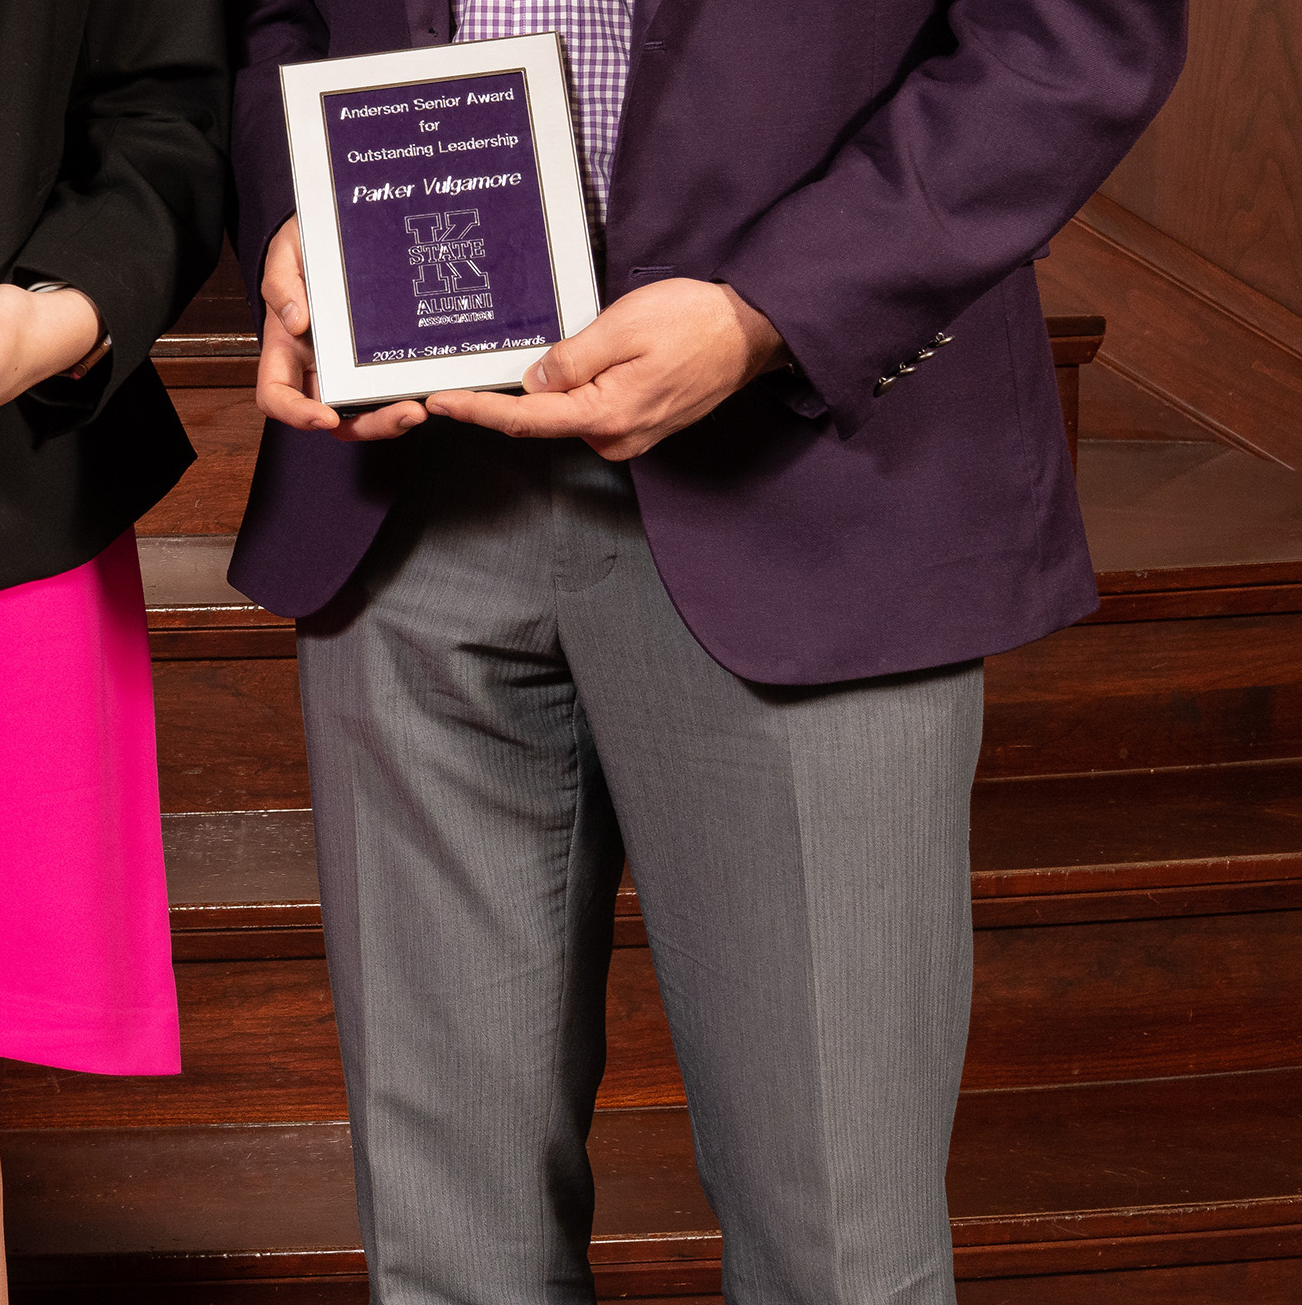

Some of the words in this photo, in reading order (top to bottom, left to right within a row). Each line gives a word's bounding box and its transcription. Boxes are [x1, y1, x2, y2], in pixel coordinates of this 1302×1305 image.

[340, 100, 409, 120] Anderson
[413, 95, 461, 111] Senior
[466, 88, 515, 105] Award
[418, 119, 440, 133] for
[347, 142, 434, 164] Outstanding
[438, 132, 519, 154] Leadership
[352, 182, 415, 204] Parker
[422, 170, 522, 196] Vulgamore
[408, 238, 486, 266] STATE
[416, 292, 493, 315] ALUMNI
[418, 310, 495, 328] ASSOCIATION
[372, 349, 405, 363] 2023
[407, 345, 458, 359] K-State
[461, 339, 499, 353] Senior
[501, 334, 546, 349] Awards
